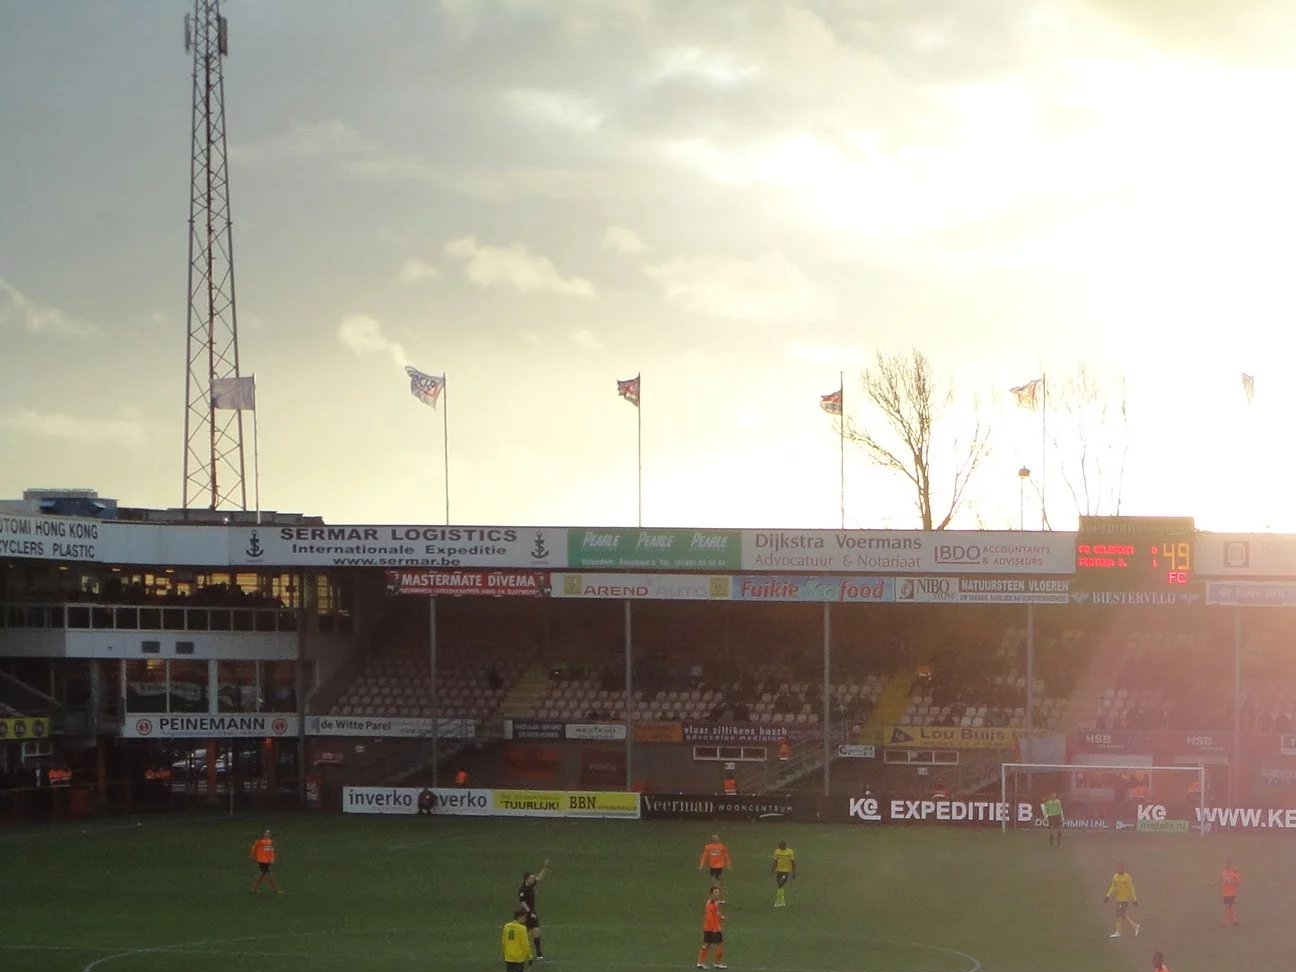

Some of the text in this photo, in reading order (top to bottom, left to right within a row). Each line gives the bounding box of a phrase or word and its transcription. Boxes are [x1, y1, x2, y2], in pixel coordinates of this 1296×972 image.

[36, 521, 66, 537] HONG
[69, 523, 99, 540] KONG
[280, 528, 518, 542] SERMAR LOGISTICS
[755, 533, 923, 551] Dijkstra Voermans
[53, 543, 96, 558] PLASTIC
[291, 544, 507, 557] Internationale Expeditie
[940, 546, 981, 561] BDO
[983, 546, 1051, 554] ACCOUNTANTS
[333, 556, 461, 567] www.sermar.be
[755, 553, 922, 569] Advocatuur & Notariaat
[993, 558, 1044, 566] ADVISEURS
[401, 574, 536, 587] MASTERMATE DIVEMA
[961, 579, 1069, 592] NATUURSTEEN VLOEREN
[583, 585, 649, 597] AREND
[1092, 591, 1176, 605] BIESTERVELD
[159, 718, 266, 731] PEINEMANN
[320, 720, 333, 730] de
[335, 720, 364, 731] Witte
[366, 720, 392, 731] Parel
[920, 728, 955, 740] Lou
[961, 728, 1006, 742] Buijs
[1086, 734, 1112, 744] HSB
[348, 789, 413, 806] inverko
[433, 791, 487, 808] nverko
[568, 796, 597, 809] BBN
[643, 795, 714, 813] Veerman
[717, 804, 793, 813] WOONCENTRUM
[890, 800, 1010, 822] EXPEDITIE
